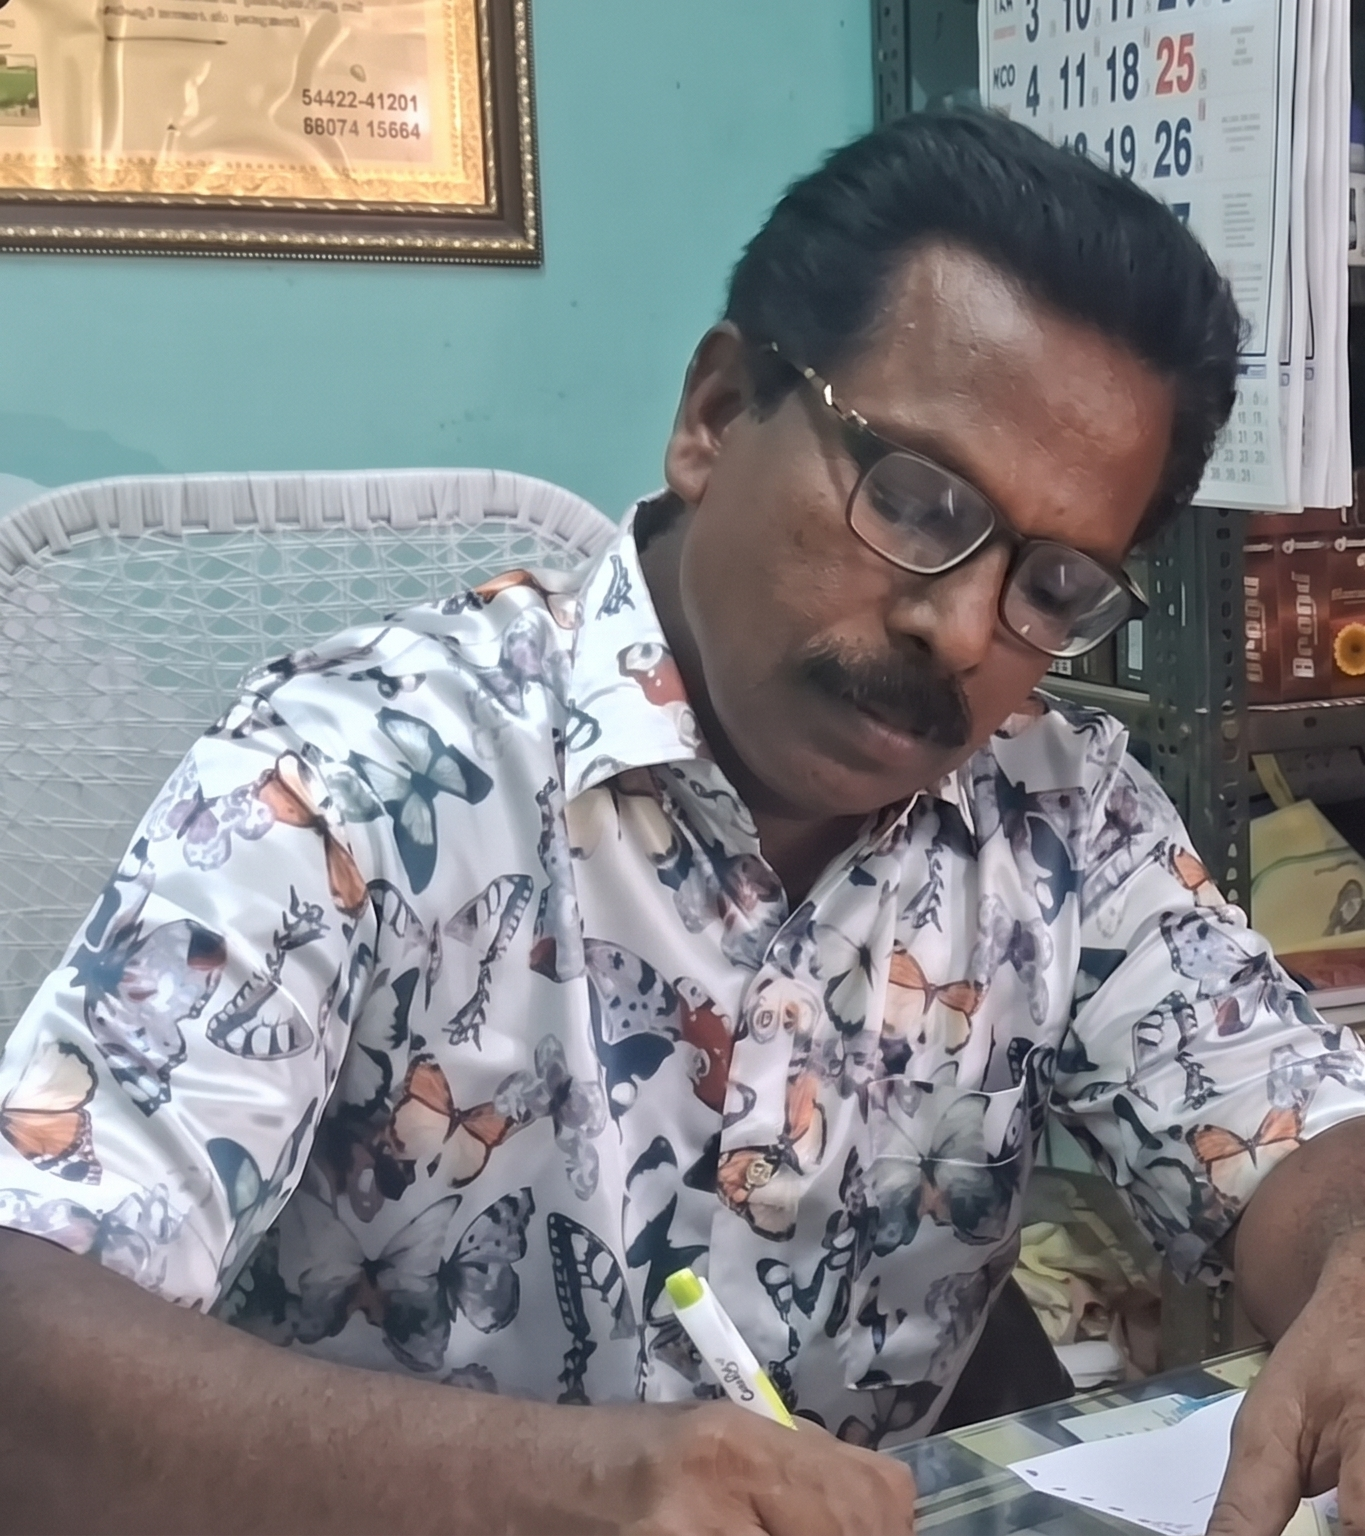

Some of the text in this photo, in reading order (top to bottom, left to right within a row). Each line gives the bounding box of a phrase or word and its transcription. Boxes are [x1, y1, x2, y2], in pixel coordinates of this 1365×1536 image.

[1026, 0, 1040, 43] 3
[1026, 65, 1040, 117] 4
[1060, 52, 1086, 110] 11
[1106, 42, 1139, 102] 18
[1155, 32, 1195, 95] 25
[367, 119, 421, 140] 15664
[1104, 125, 1136, 180] 19
[1153, 117, 1192, 179] 26
